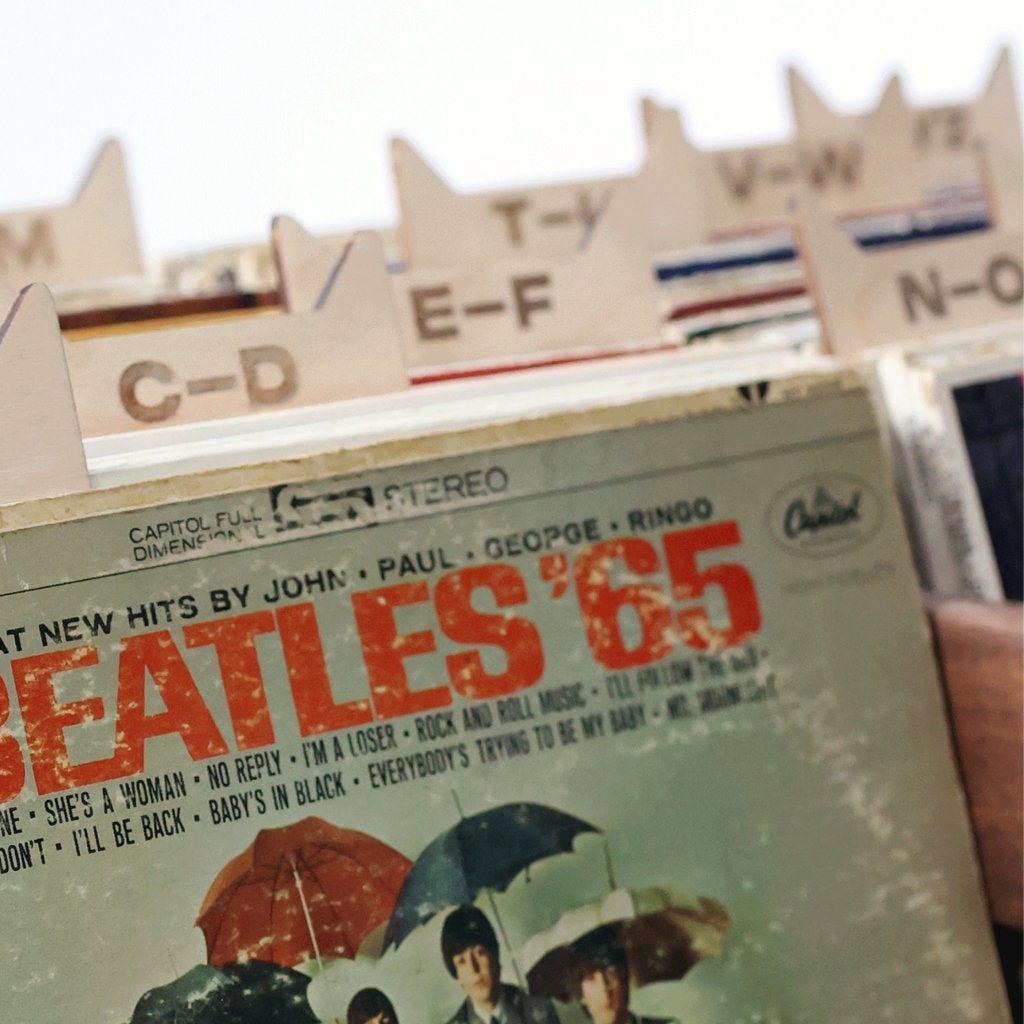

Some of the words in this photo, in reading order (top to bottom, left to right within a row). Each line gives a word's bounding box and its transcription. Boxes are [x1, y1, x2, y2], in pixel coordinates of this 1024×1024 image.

[410, 272, 550, 341] E-F
[119, 345, 299, 423] C-D
[129, 515, 211, 544] CAPITOL
[215, 507, 264, 533] FULL
[384, 467, 509, 511] STEREO
[38, 611, 114, 647] NEW
[127, 595, 198, 629] HITS
[210, 584, 250, 613] BY
[264, 569, 347, 603] JOHN
[377, 548, 455, 580] PAUL
[484, 518, 601, 559] GEORGE
[627, 497, 714, 531] RINGO
[44, 791, 94, 826] SHE'S
[102, 787, 114, 814] A
[119, 771, 187, 809] WOMAN
[206, 762, 230, 790] NO
[234, 750, 282, 784] REPLY
[302, 740, 328, 768] I'M
[333, 736, 345, 762] A
[348, 724, 399, 758] LOSER
[414, 710, 458, 743] ROCK
[462, 703, 493, 731] AND
[496, 696, 535, 724] ROLL
[538, 681, 587, 715] MUSIC
[72, 825, 106, 857] I'LL
[112, 819, 135, 848] BE
[141, 808, 186, 842] BACK
[209, 789, 266, 825] BABY'S
[272, 784, 290, 811] IN
[294, 771, 346, 806] BLACK
[367, 743, 470, 789] EVERYBODY'S
[475, 729, 531, 764] TRYING
[532, 724, 555, 751] TO
[557, 719, 578, 746] BE
[580, 713, 605, 740] MY
